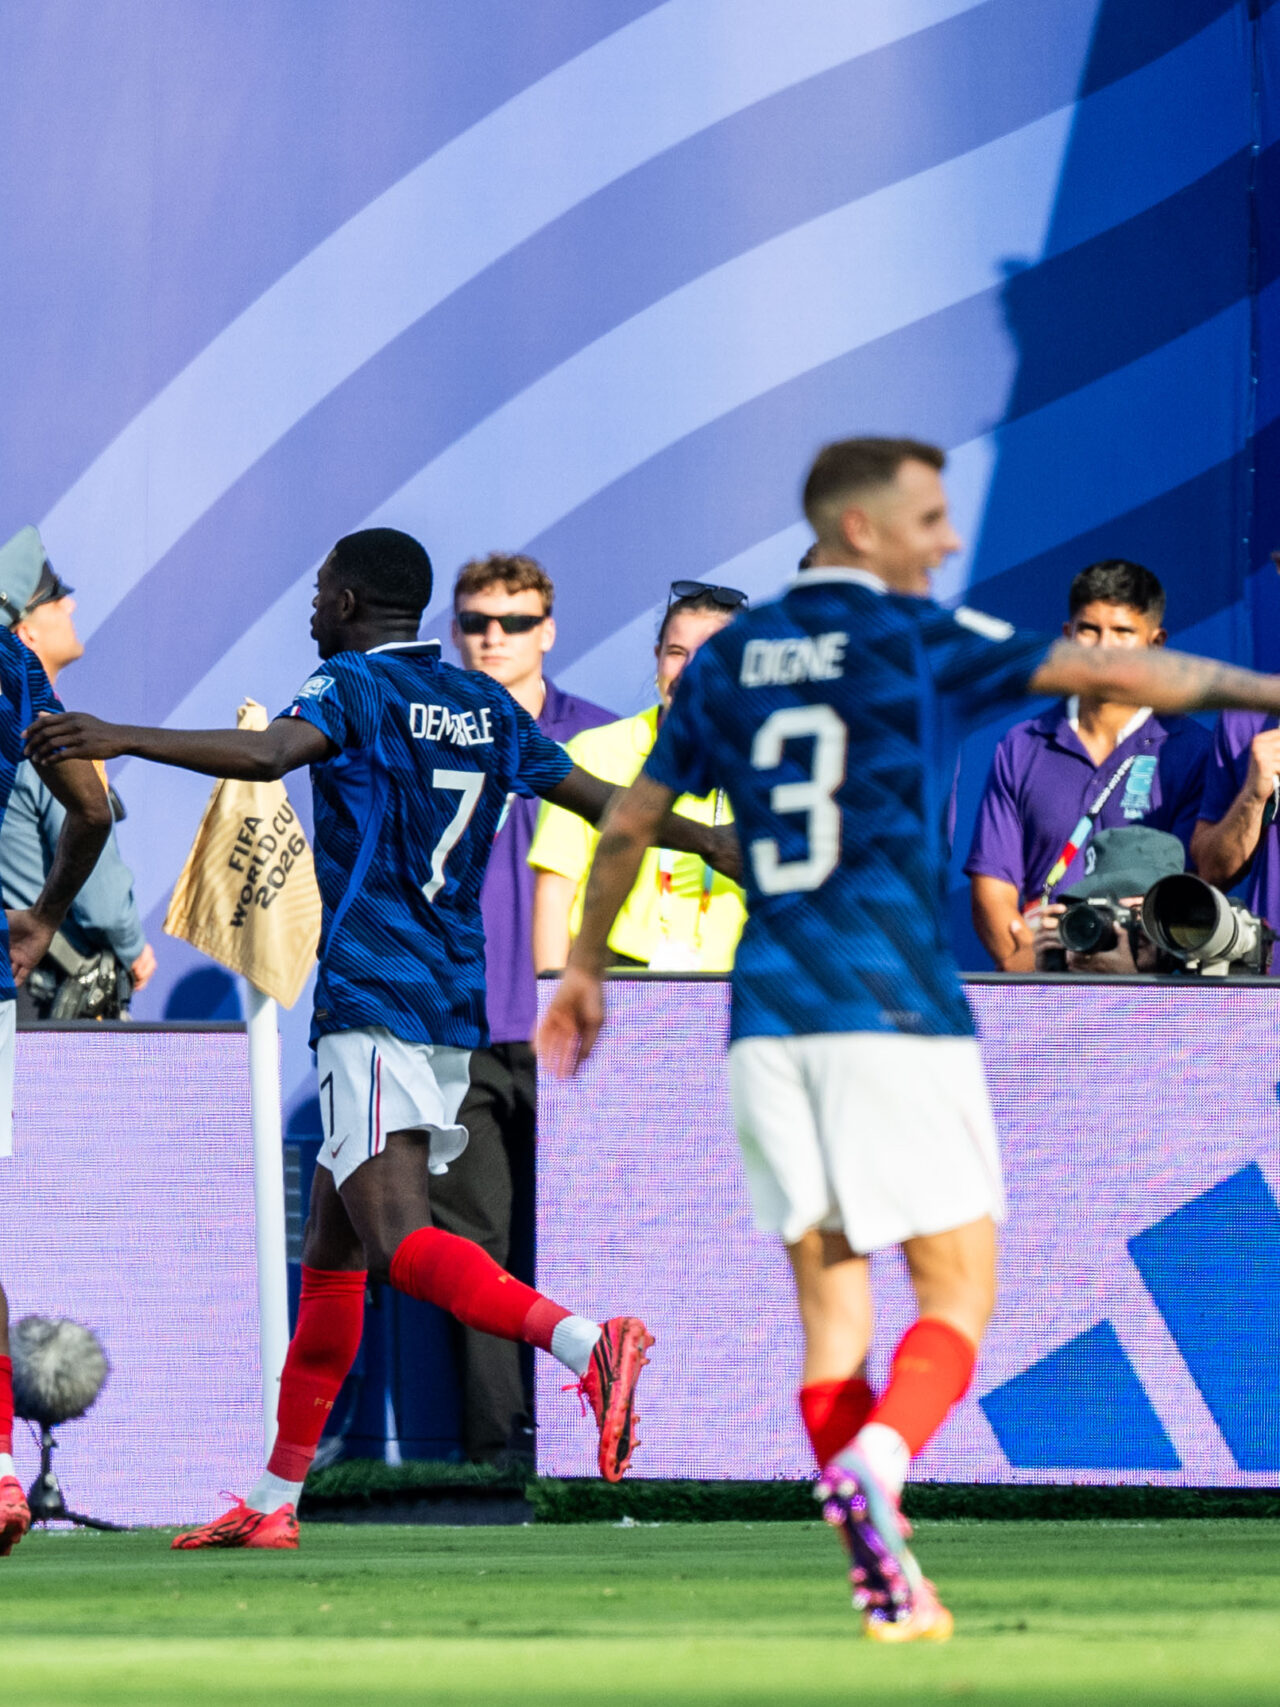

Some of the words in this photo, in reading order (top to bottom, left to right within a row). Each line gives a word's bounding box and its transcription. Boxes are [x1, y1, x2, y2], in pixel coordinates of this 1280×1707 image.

[740, 631, 850, 688] DIGNE
[228, 816, 264, 874] FIFA
[421, 768, 486, 904] 7
[750, 703, 848, 896] 3
[230, 834, 277, 928] WORLD
[272, 803, 295, 836] CU
[255, 832, 306, 910] 2026
